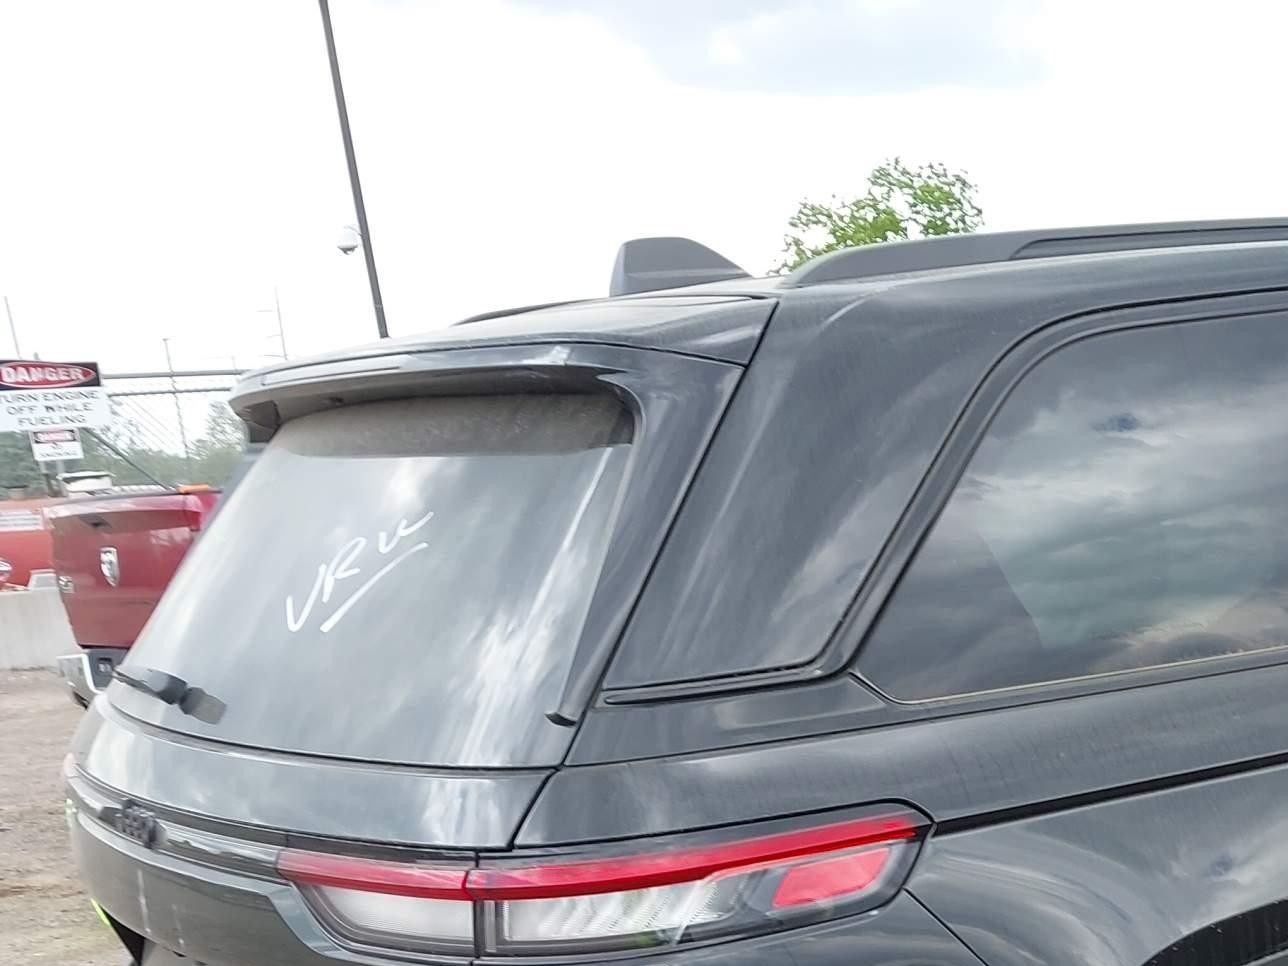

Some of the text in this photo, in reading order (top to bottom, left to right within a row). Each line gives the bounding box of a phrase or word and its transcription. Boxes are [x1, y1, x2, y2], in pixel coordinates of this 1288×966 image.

[1, 366, 84, 383] DANGER
[43, 390, 99, 402] ENGINE
[6, 402, 94, 416] OFF WHILE
[17, 414, 87, 426] FUELING
